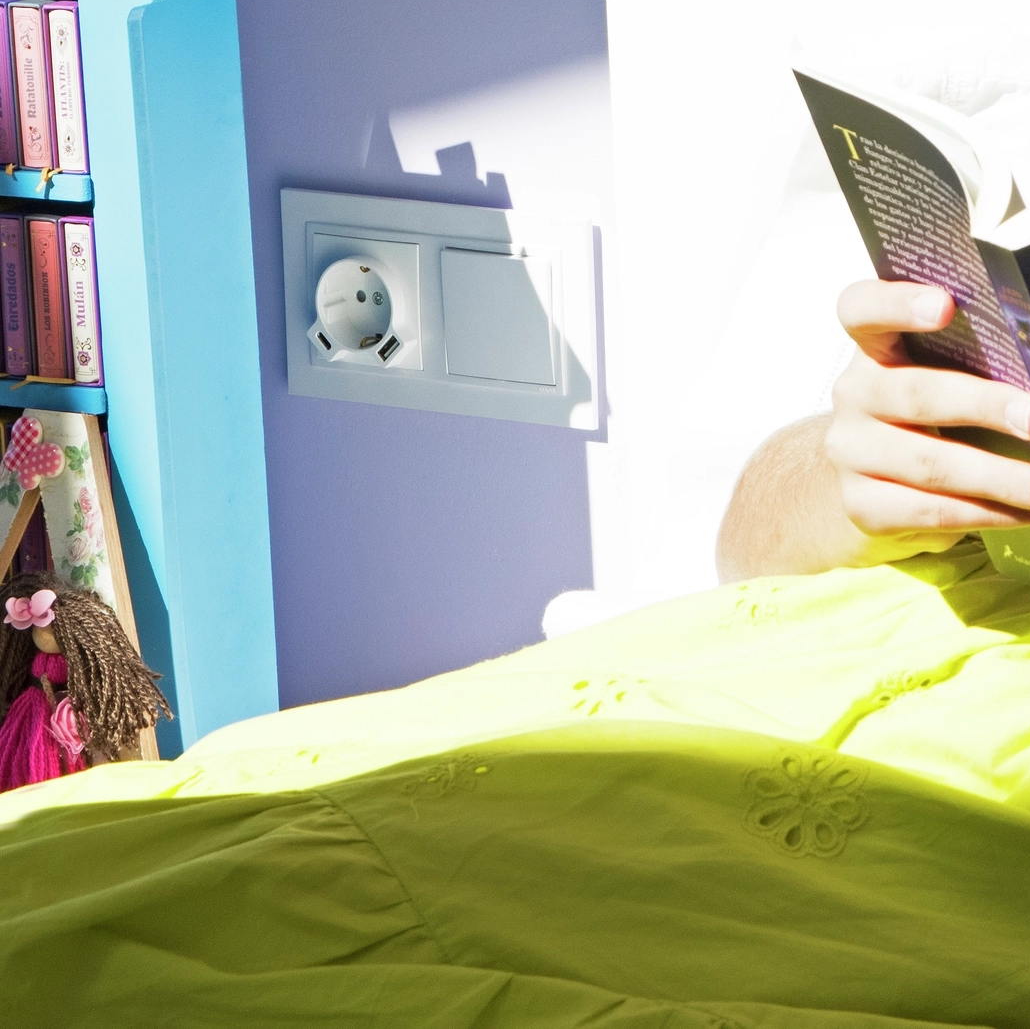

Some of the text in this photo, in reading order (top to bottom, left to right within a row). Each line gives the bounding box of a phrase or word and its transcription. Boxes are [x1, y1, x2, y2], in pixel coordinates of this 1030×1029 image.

[24, 58, 36, 119] Ratatouille
[58, 61, 68, 120] ATLANTIS:
[6, 262, 19, 332] Enredados
[42, 272, 50, 313] ROBINSON
[73, 280, 86, 328] Mulán
